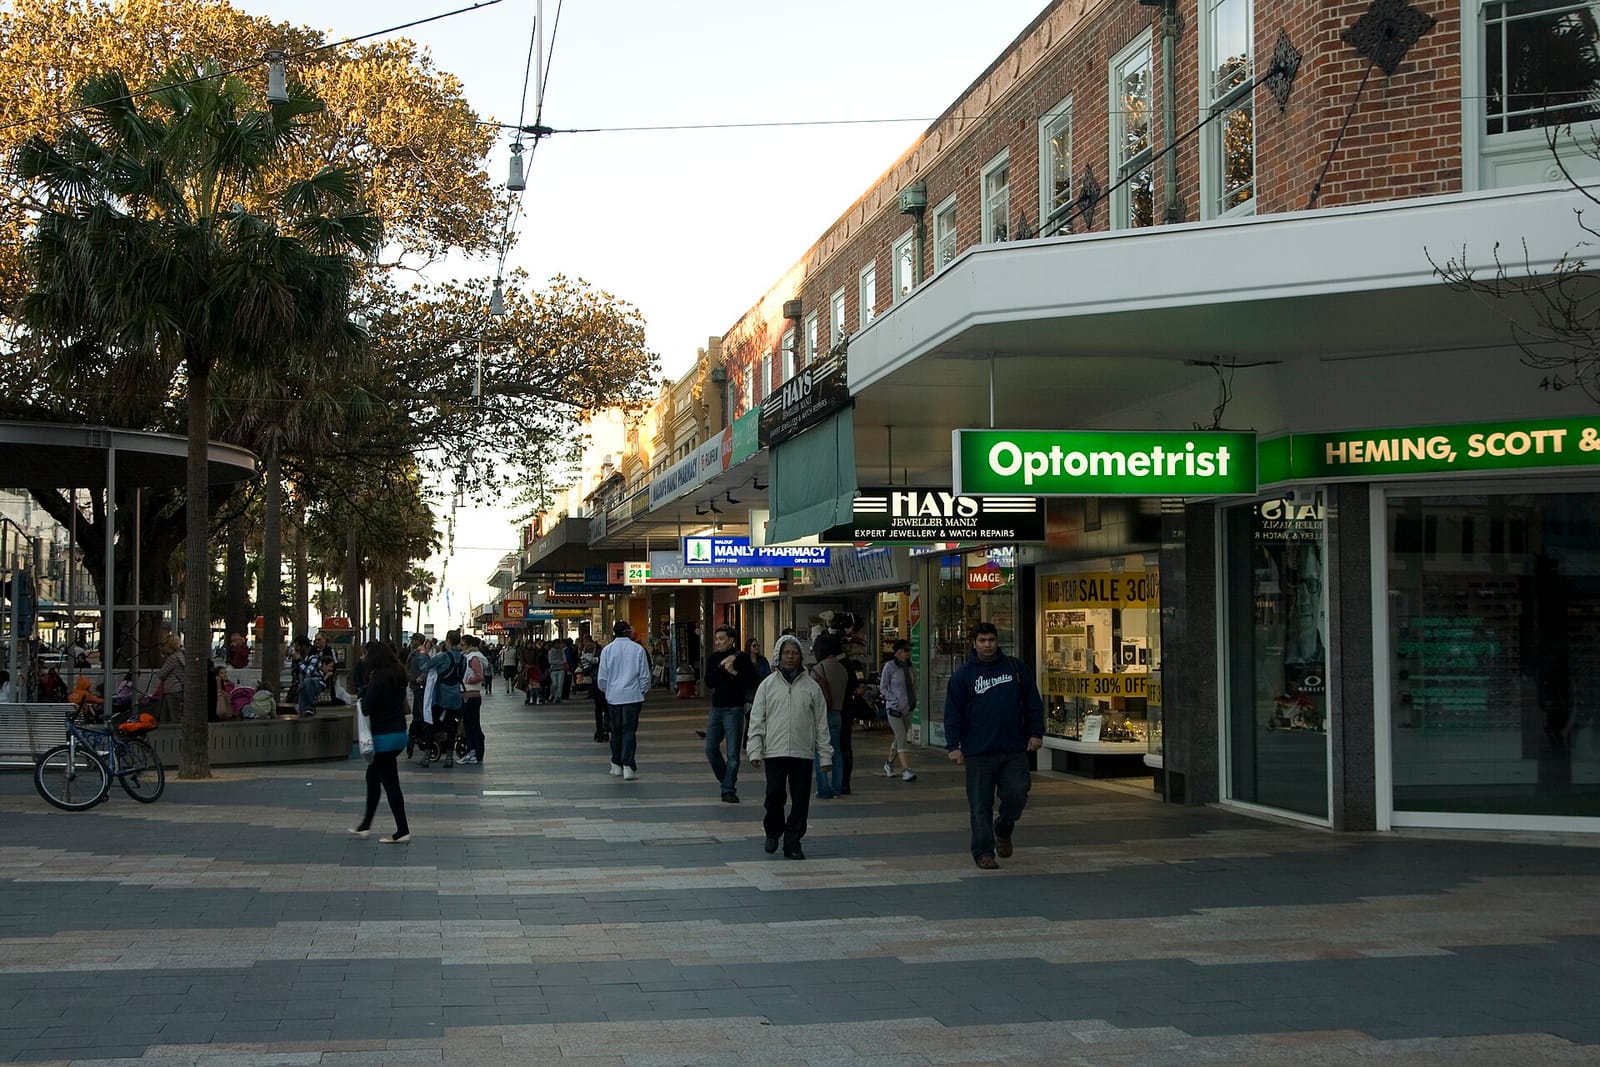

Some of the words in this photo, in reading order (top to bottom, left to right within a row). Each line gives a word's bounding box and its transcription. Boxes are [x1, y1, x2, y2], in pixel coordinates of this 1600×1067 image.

[783, 370, 812, 410] HAYS
[1326, 436, 1457, 464] HEMING,
[1467, 429, 1567, 458] SCOTT
[1578, 428, 1600, 451] &
[988, 441, 1231, 485] Optometrist
[892, 491, 979, 517] HAYS
[891, 518, 943, 527] JEWELLER
[945, 518, 978, 527] MANLY
[854, 530, 886, 538] EXPERT
[889, 530, 937, 538] JEWELLERY
[939, 530, 946, 538] &
[948, 530, 977, 538] WATCH
[980, 530, 1015, 538] REPAIRS
[715, 545, 756, 556] MANLY
[758, 547, 827, 556] PHARMACY
[629, 569, 642, 578] 24
[969, 573, 1001, 583] IMAGE
[1079, 579, 1121, 601] SALE
[1094, 678, 1121, 693] 30%
[1125, 677, 1146, 692] OFF
